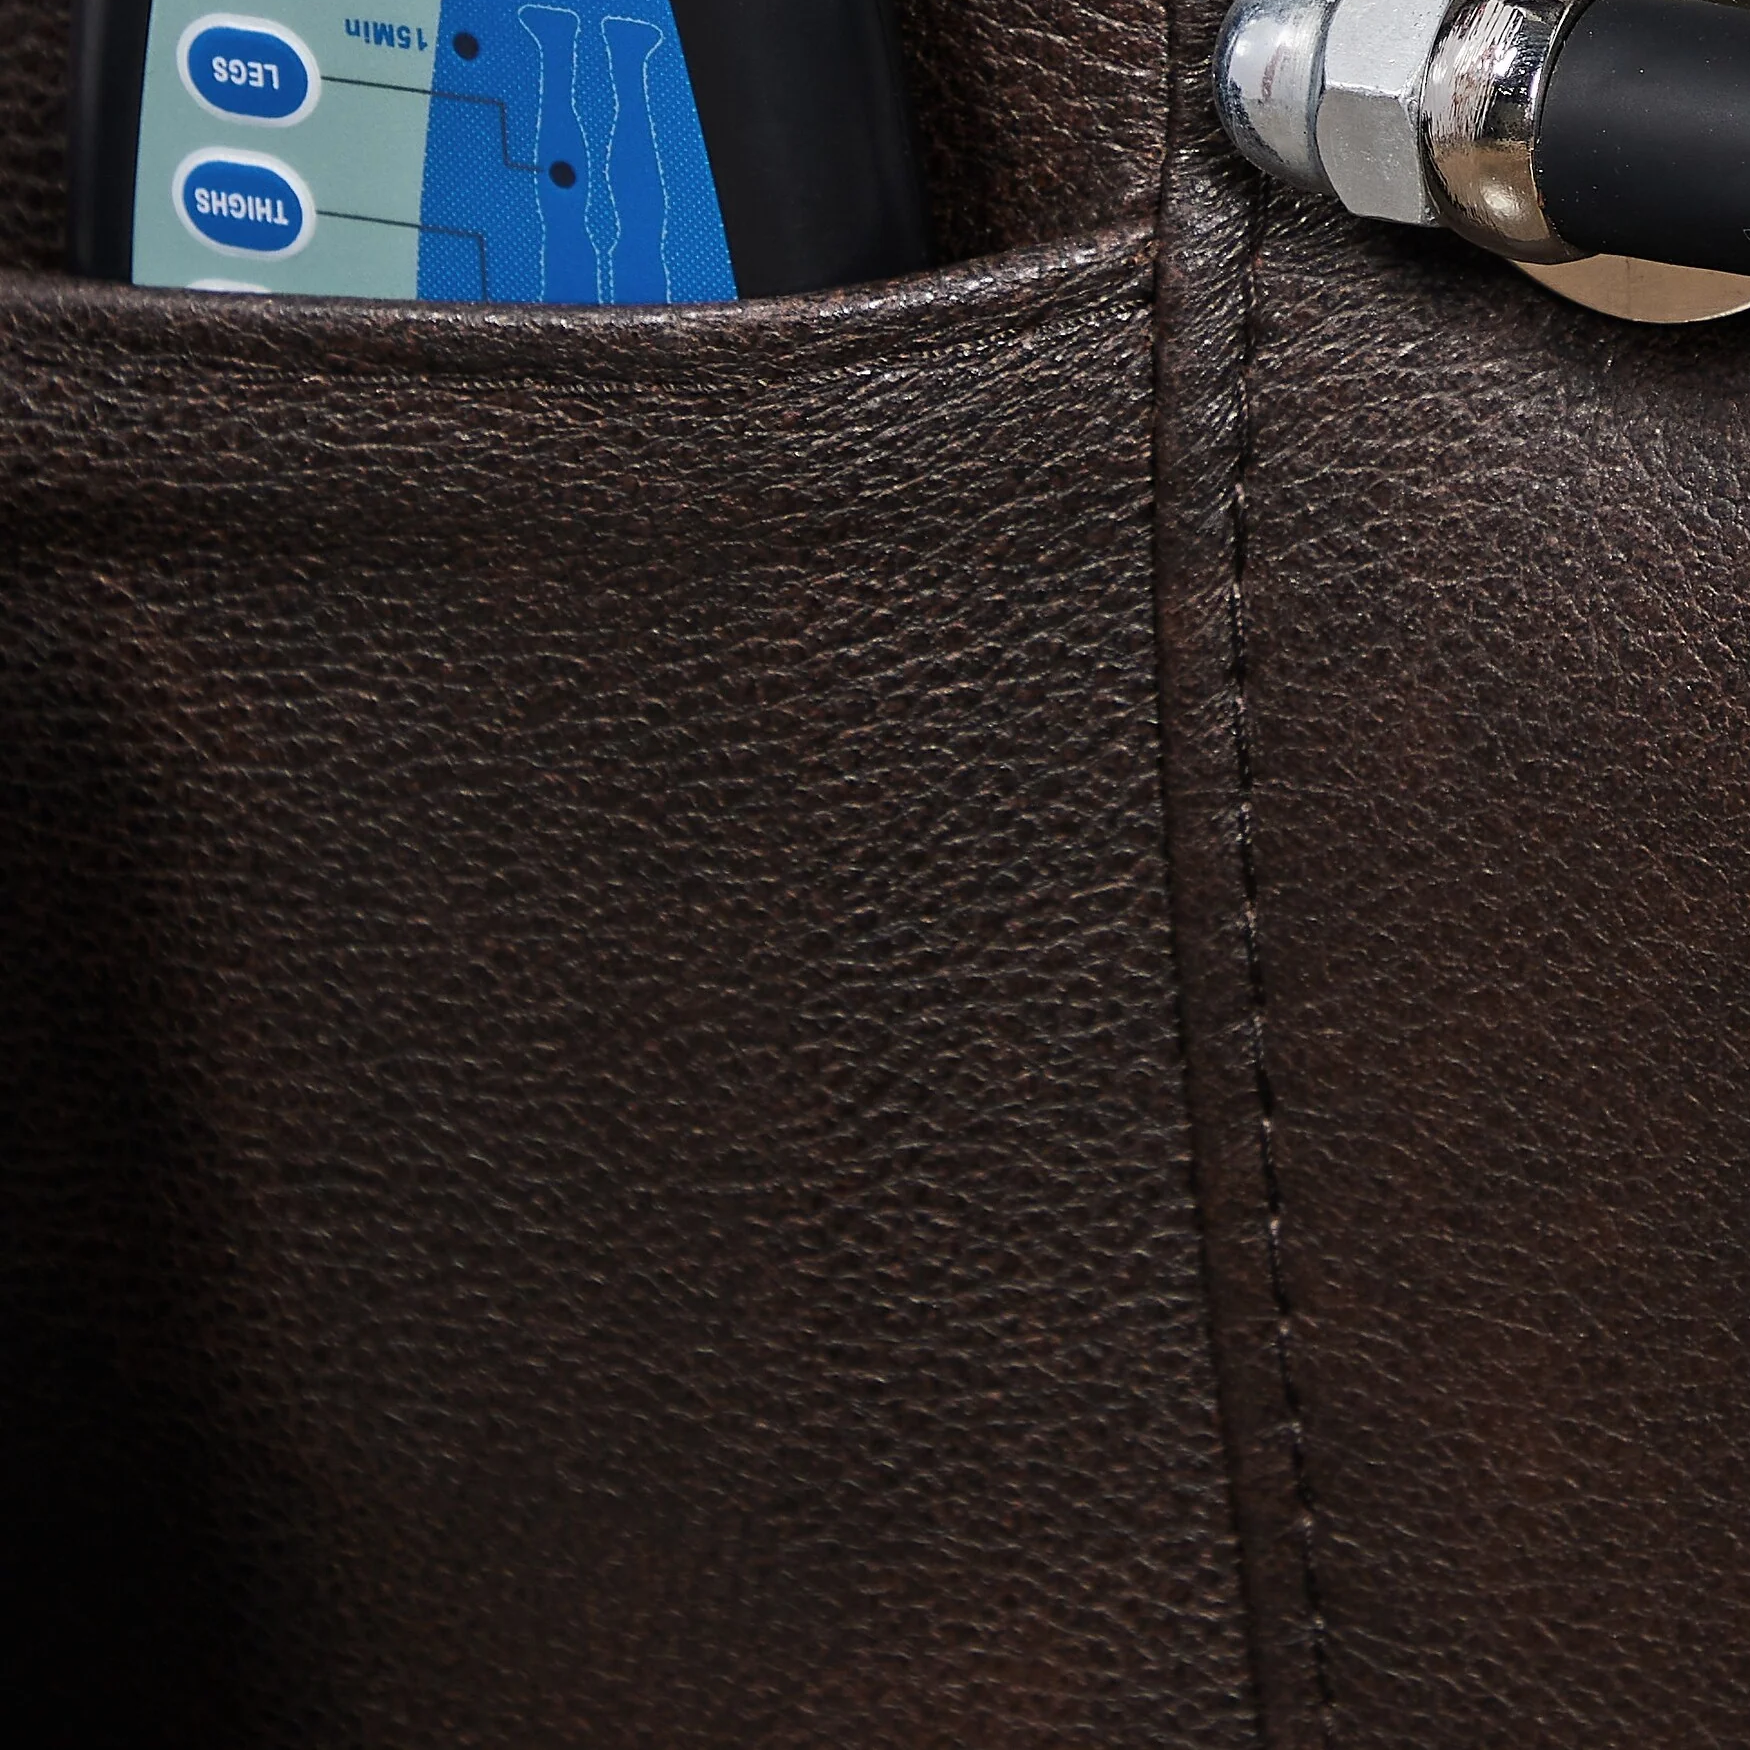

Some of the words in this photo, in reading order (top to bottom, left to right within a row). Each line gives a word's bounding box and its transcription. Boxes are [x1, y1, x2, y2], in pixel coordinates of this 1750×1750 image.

[344, 17, 428, 52] 15Min
[212, 57, 280, 91] LEGS
[194, 187, 289, 227] THIGHS
